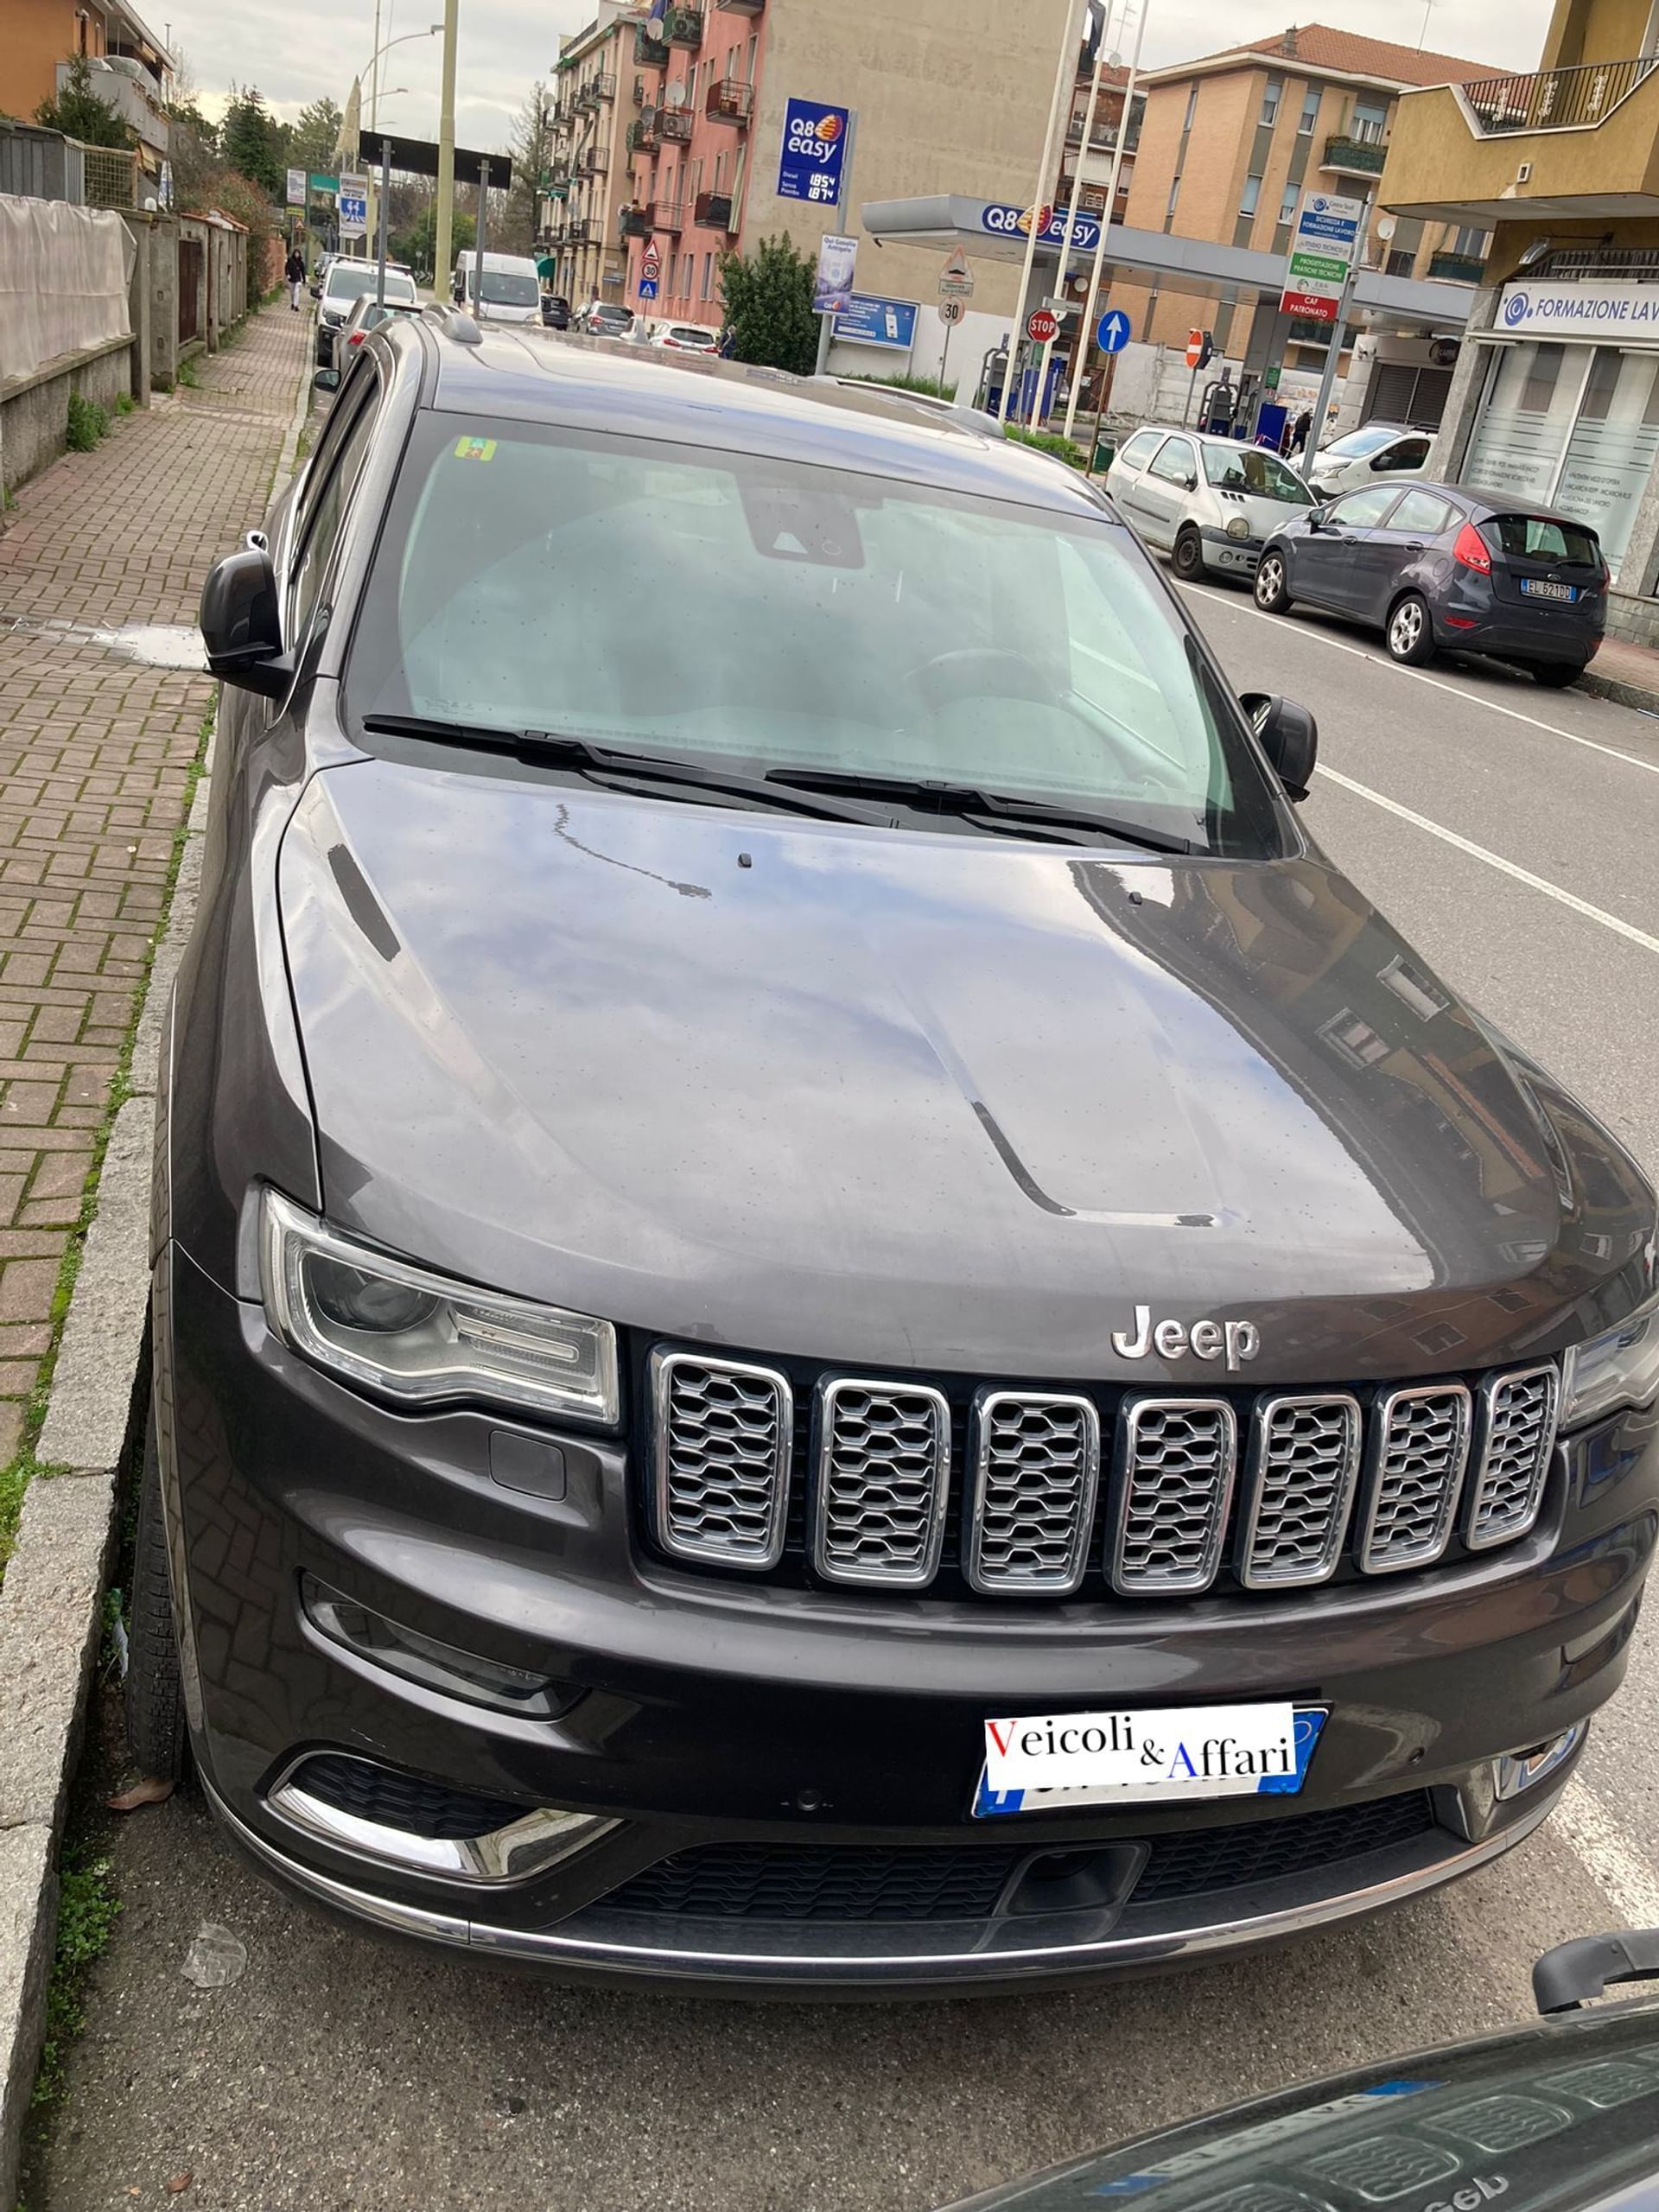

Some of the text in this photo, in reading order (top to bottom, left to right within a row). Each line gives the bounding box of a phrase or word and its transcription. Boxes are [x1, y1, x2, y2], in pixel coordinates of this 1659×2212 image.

[790, 118, 815, 137] Q8
[787, 137, 836, 163] easy
[987, 207, 1016, 231] Q8
[645, 266, 655, 276] 30
[944, 303, 958, 319] 30
[1290, 304, 1328, 318] PATRONATO
[1535, 299, 1629, 320] FORMAZIONE
[1031, 319, 1055, 334] STOP
[1111, 1305, 1261, 1371] Jeep
